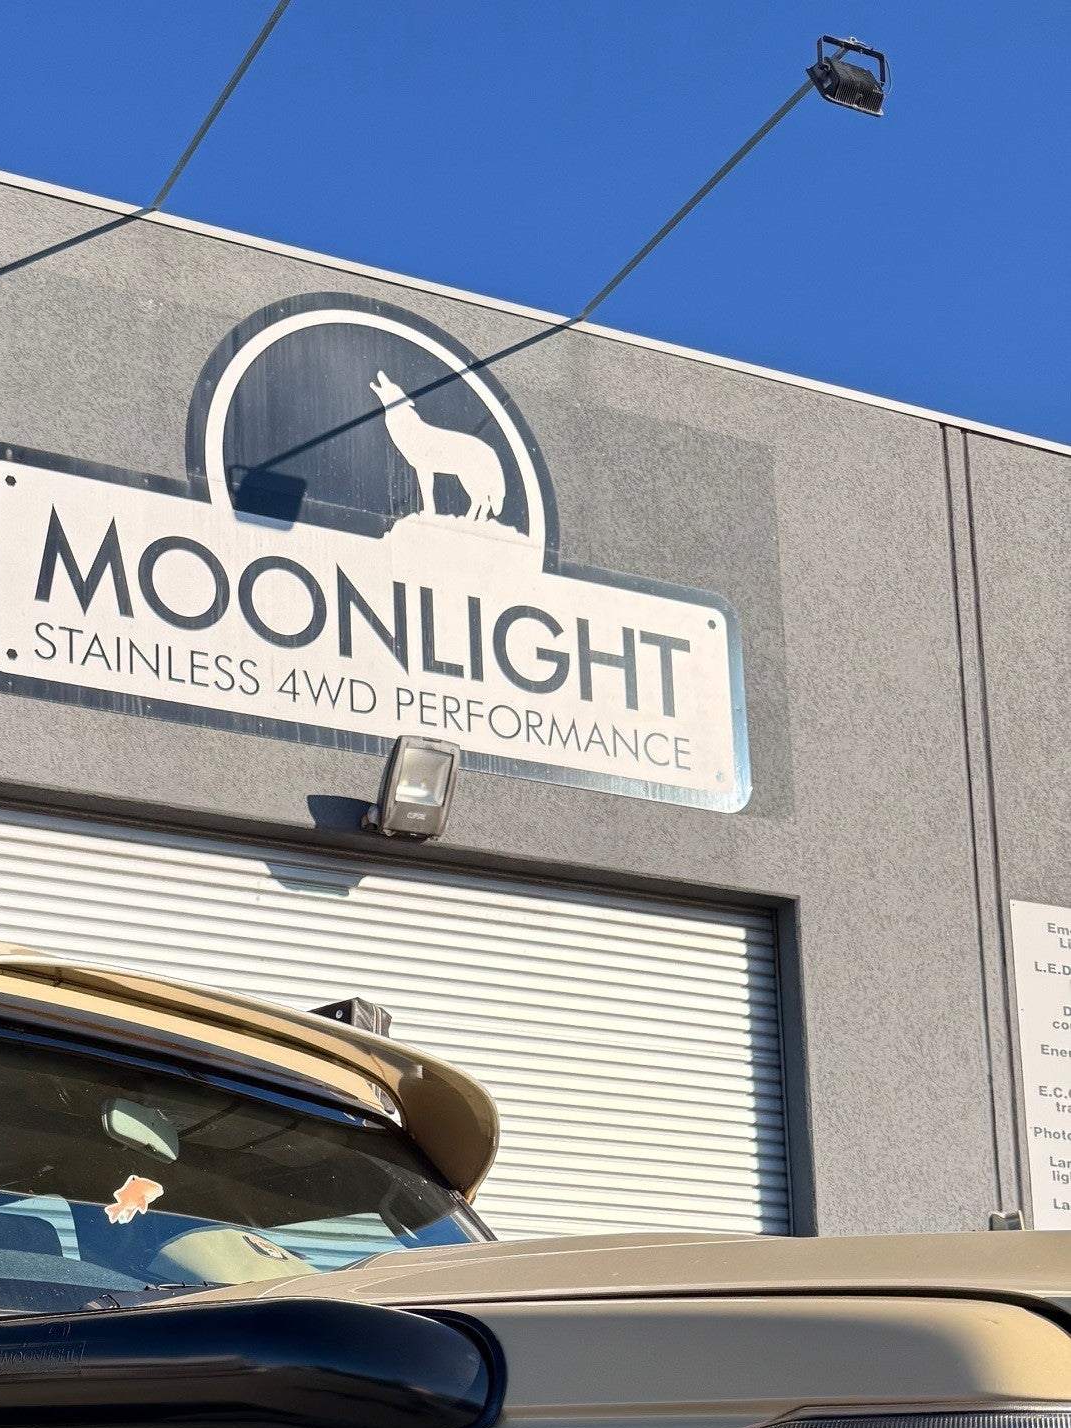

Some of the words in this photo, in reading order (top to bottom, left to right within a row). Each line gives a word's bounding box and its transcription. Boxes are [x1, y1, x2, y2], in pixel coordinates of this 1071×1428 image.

[34, 505, 692, 718] MOONLIGHT
[34, 622, 260, 697] STAINLESS
[277, 667, 378, 714] 4WD
[395, 687, 692, 770] PERFORMANCE
[1047, 922, 1071, 936] Em
